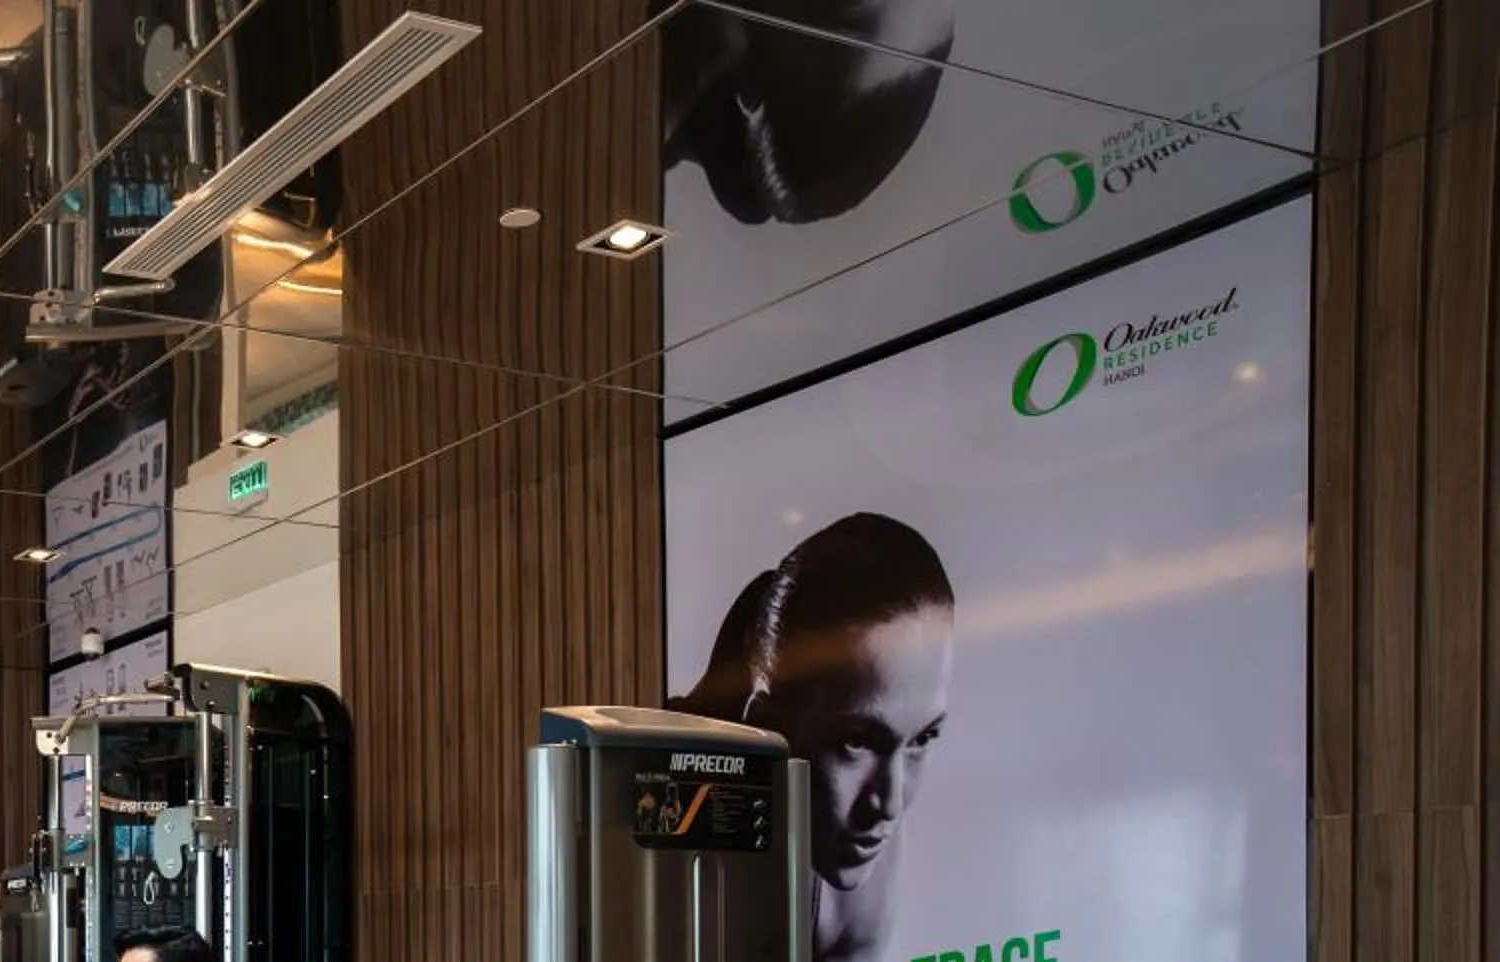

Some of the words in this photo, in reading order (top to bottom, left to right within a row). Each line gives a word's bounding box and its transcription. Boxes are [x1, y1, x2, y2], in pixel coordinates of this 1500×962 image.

[1103, 287, 1238, 353] Oakwood
[1103, 321, 1219, 371] RESIDENCE
[683, 753, 746, 775] PRECOR
